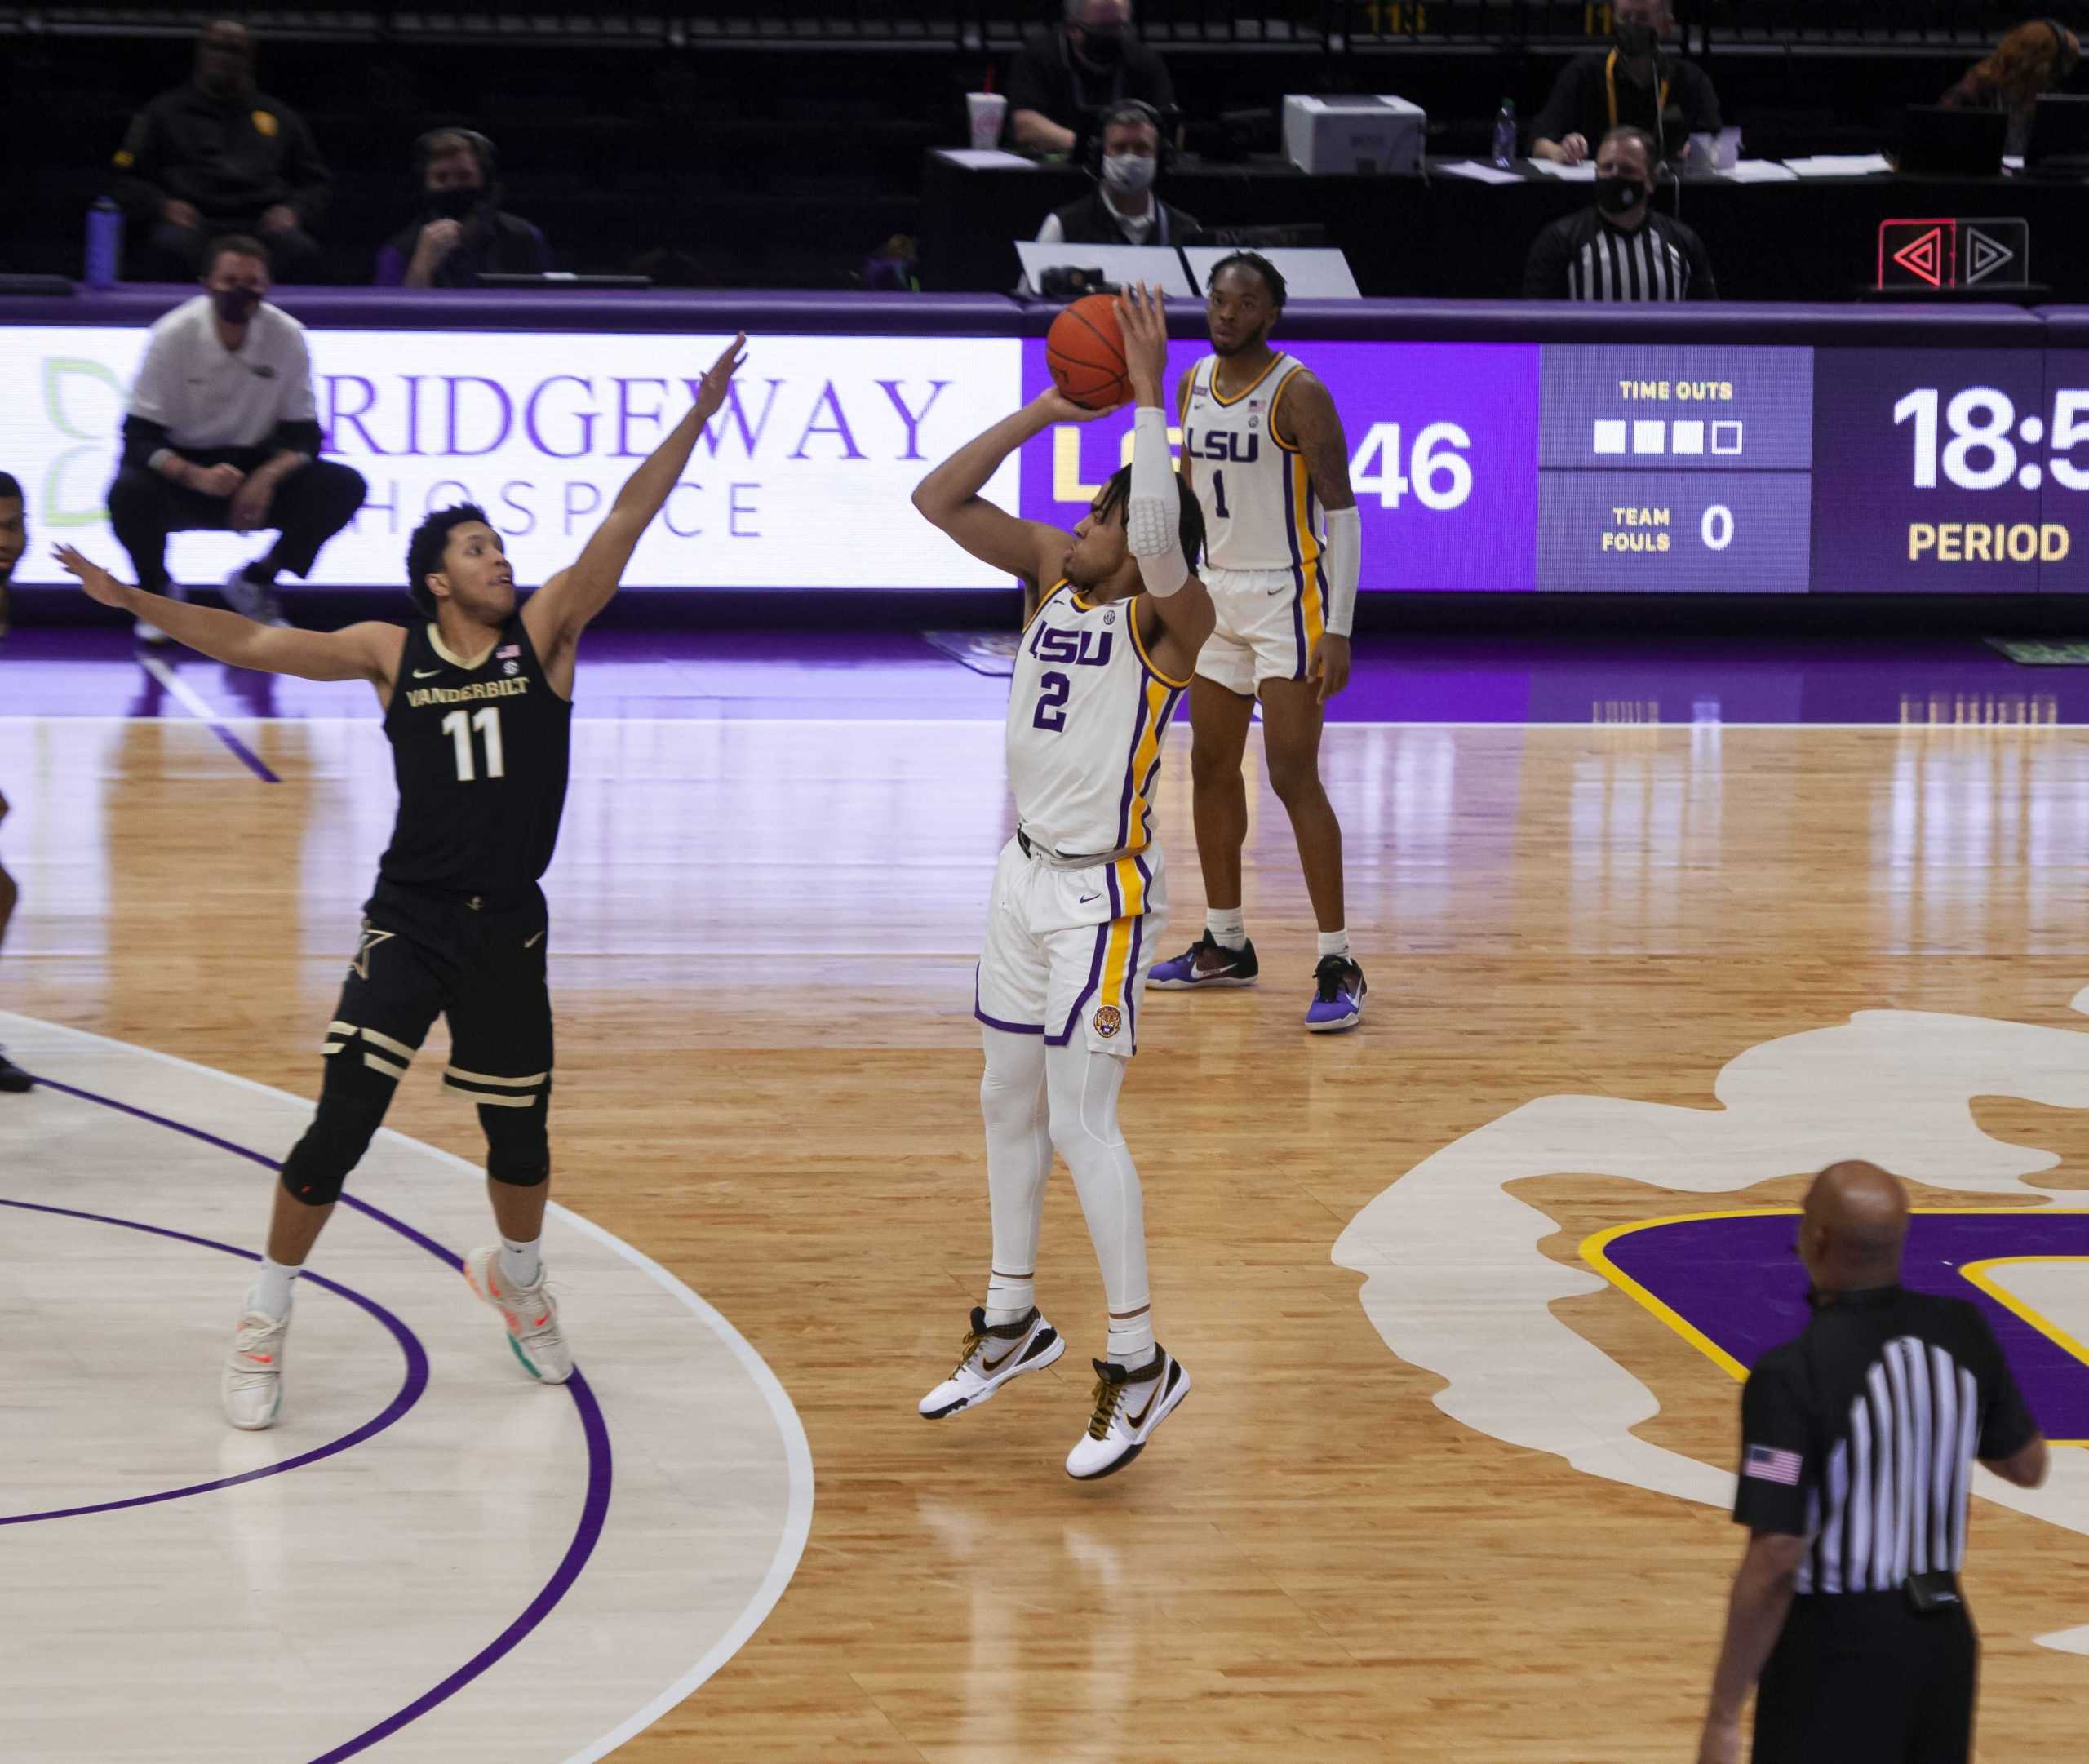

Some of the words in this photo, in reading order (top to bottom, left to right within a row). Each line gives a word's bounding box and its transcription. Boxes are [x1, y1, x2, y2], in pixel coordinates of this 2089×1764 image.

[1619, 380, 1670, 401] TIME
[1675, 381, 1733, 401] OUTS
[1187, 427, 1258, 463] LSU
[1348, 421, 1473, 511] 46
[1213, 469, 1230, 518] 1
[1612, 507, 1670, 525] TEAM
[1700, 504, 1735, 551] 0
[1601, 531, 1670, 552] FOULS
[1909, 523, 2070, 562] PERIOD
[1029, 619, 1113, 666] LSU
[406, 676, 530, 707] VANDERBILT
[1032, 671, 1070, 733] 2
[441, 707, 504, 782] 11
